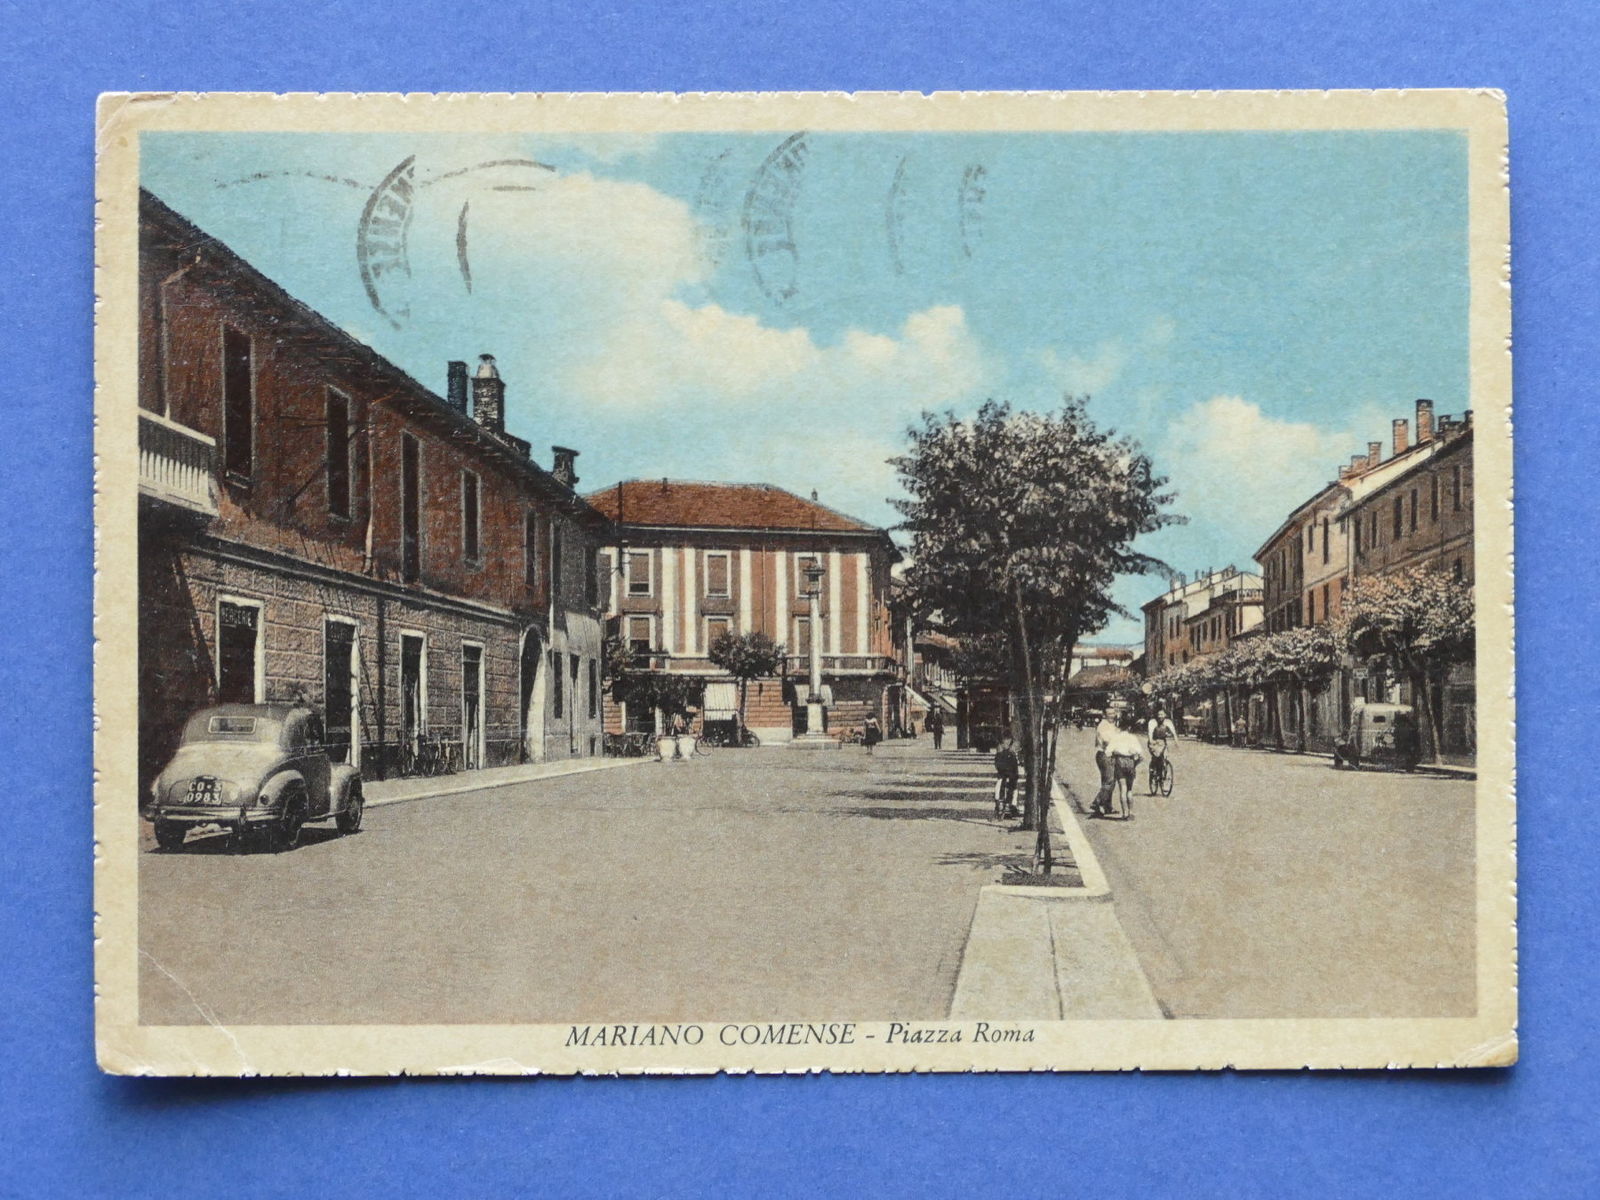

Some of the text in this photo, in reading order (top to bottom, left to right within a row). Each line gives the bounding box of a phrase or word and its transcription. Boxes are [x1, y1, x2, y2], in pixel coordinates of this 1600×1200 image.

[565, 1025, 704, 1047] MARIANO
[719, 1023, 857, 1046] COMENSE
[885, 1022, 963, 1045] Piazza
[971, 1021, 1035, 1044] Roma
